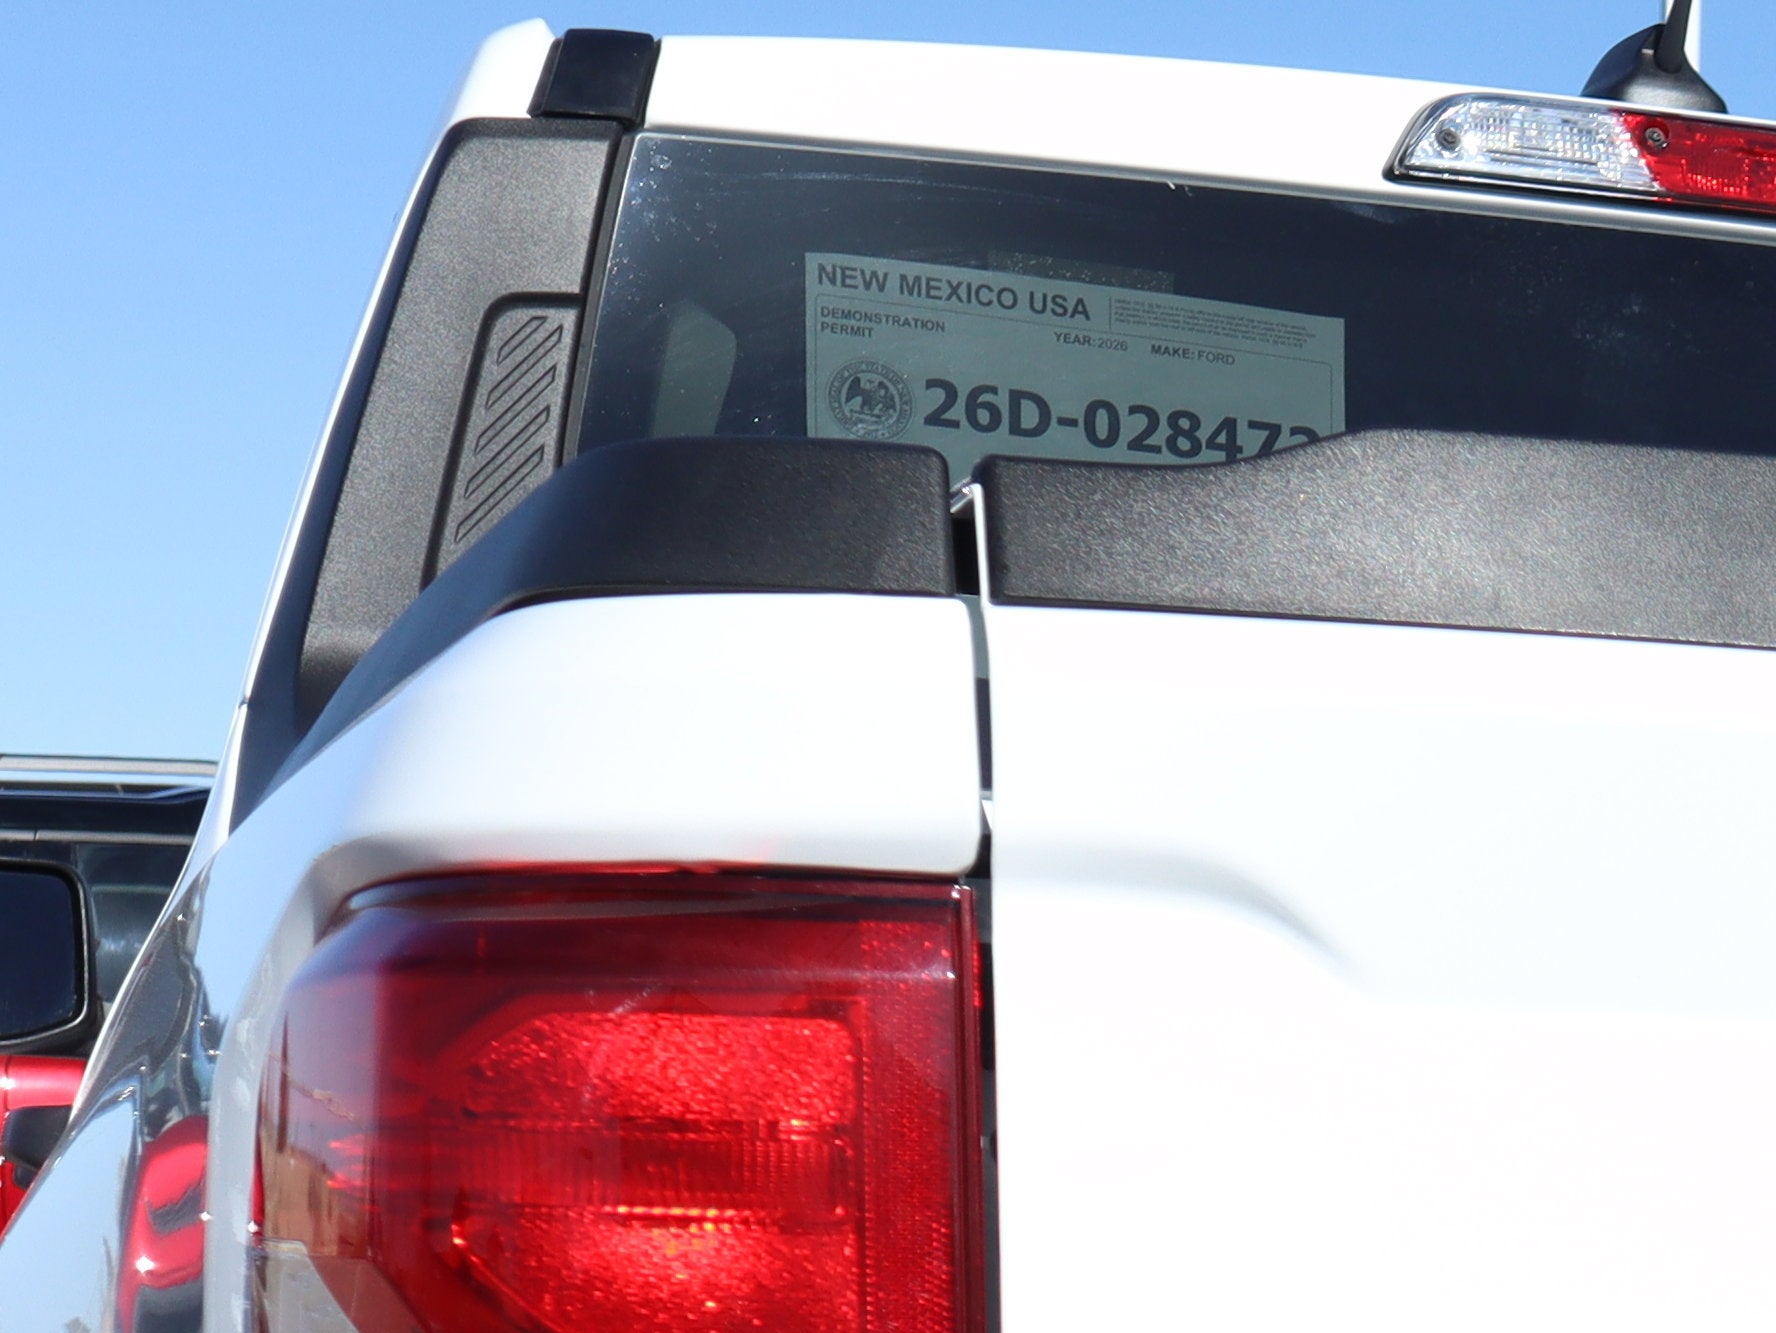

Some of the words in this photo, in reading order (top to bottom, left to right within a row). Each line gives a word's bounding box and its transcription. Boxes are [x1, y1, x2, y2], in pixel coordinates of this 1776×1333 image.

[817, 263, 888, 293] NEW
[900, 273, 1019, 310] MEXICO
[1028, 290, 1091, 321] USA
[820, 306, 946, 333] DEMONSTRATION
[820, 322, 875, 339] PERMIT
[1053, 331, 1096, 347] YEAR:
[1098, 337, 1129, 352] 2026
[1150, 343, 1195, 360] MAKE:
[1197, 350, 1236, 366] FORD
